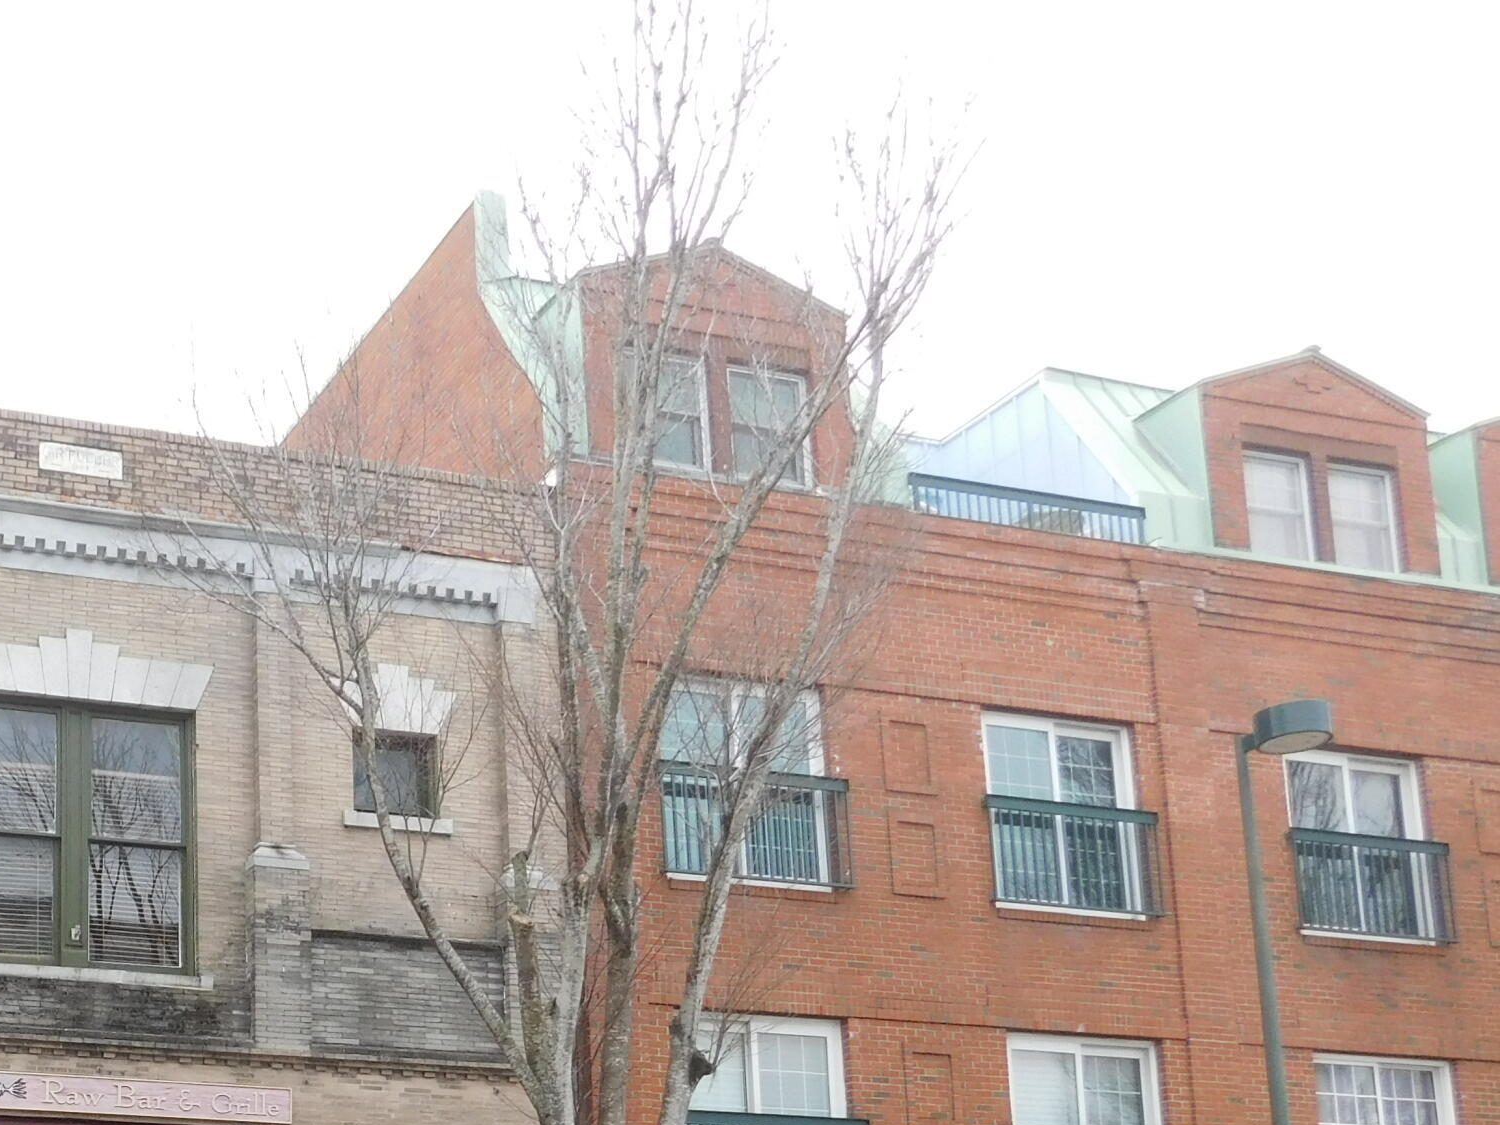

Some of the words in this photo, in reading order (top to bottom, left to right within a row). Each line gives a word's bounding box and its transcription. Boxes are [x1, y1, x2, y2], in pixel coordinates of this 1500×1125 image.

[41, 1079, 103, 1107] Raw
[114, 1083, 166, 1111] Bar
[179, 1088, 201, 1112] &
[212, 1091, 280, 1117] Grille
